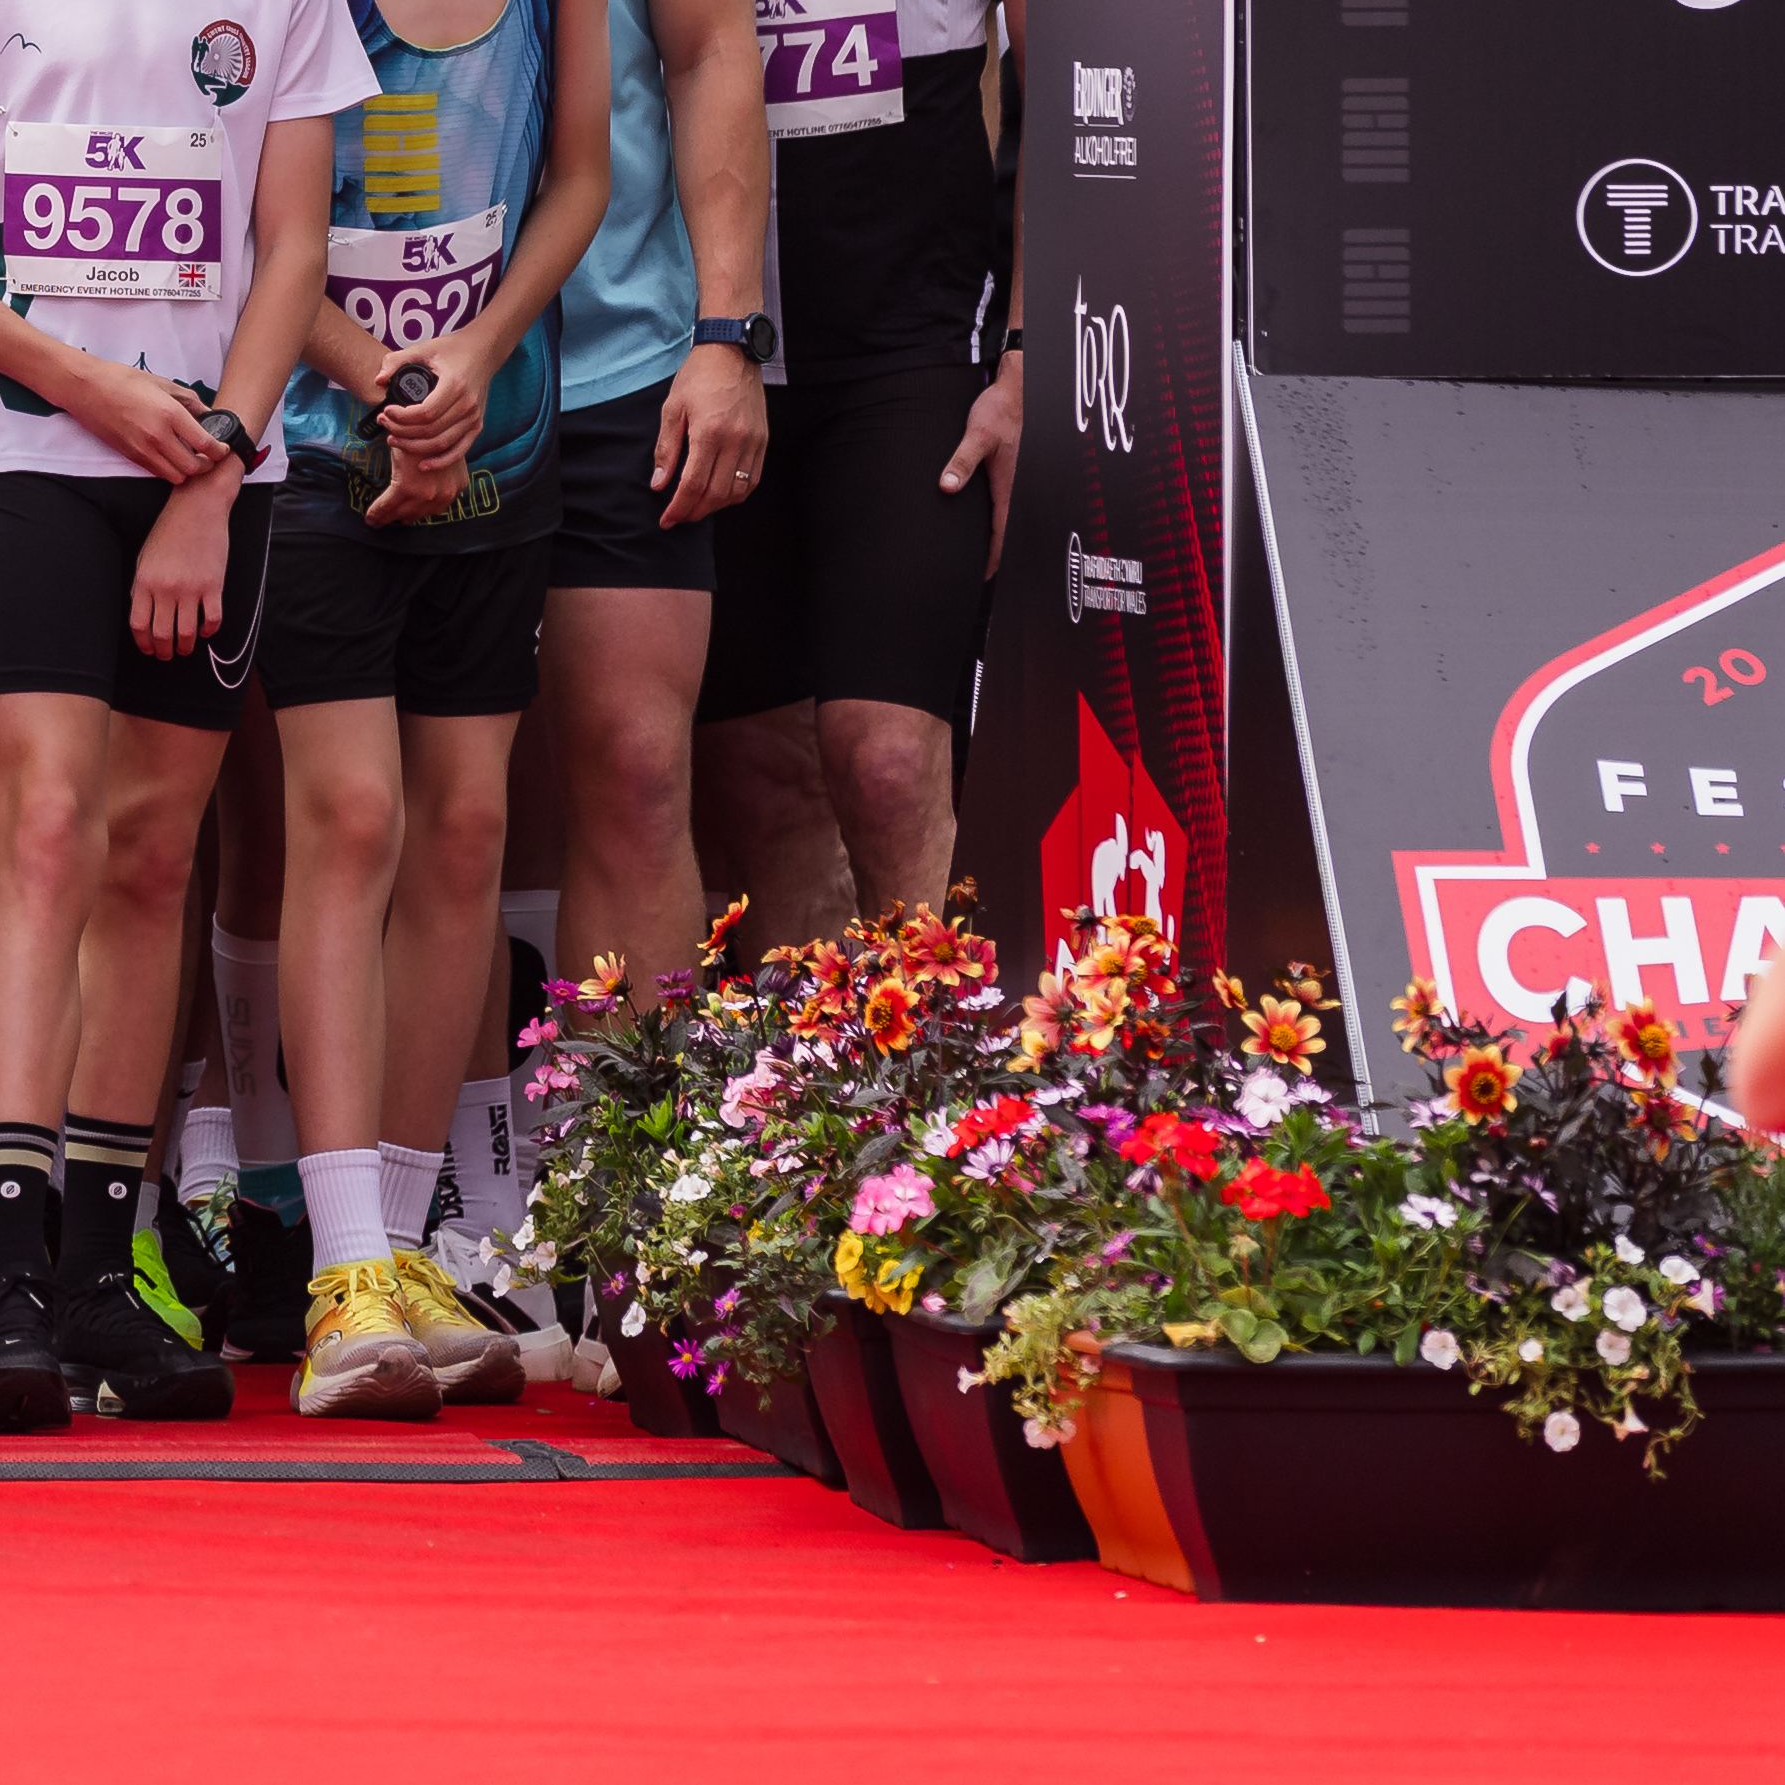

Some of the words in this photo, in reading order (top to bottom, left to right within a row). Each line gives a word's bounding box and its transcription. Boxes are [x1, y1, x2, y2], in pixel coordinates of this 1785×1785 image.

[190, 132, 207, 148] 25
[787, 125, 827, 137] HOTLINE
[85, 134, 146, 171] 5K
[22, 182, 204, 255] 9578
[401, 232, 458, 274] 5K
[21, 283, 74, 295] EMERGENCY
[77, 285, 108, 295] EVENT
[110, 286, 150, 296] HOTLINE
[86, 266, 139, 282] Jacob
[345, 263, 493, 349] 9627
[1682, 648, 1767, 707] 20
[1596, 759, 1785, 816] FE
